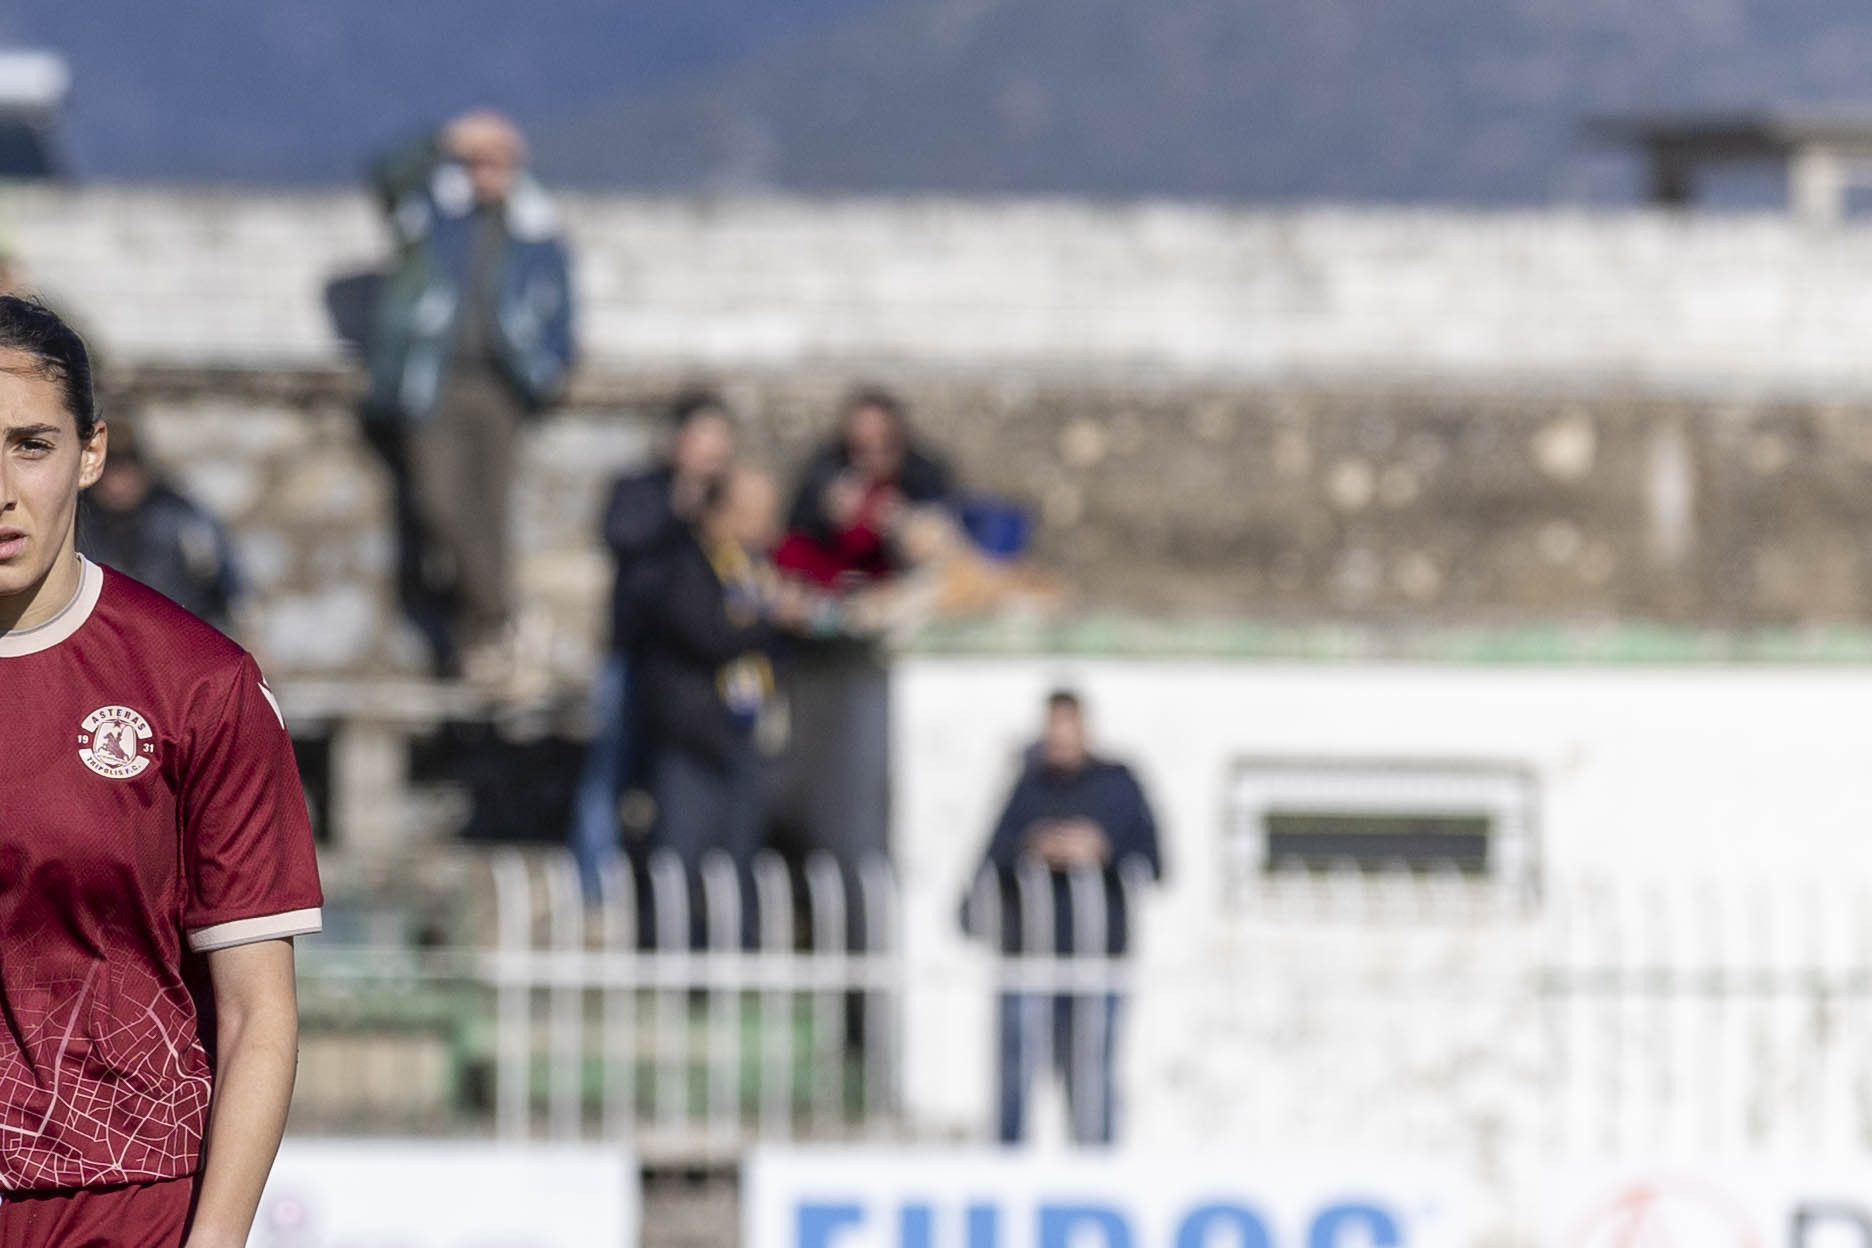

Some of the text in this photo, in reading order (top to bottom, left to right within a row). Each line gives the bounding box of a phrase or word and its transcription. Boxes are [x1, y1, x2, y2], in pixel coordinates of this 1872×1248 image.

[91, 708, 147, 732] ASTERAS
[77, 734, 89, 744] 19
[142, 743, 155, 753] 31
[86, 756, 124, 776] TRIPOLIS
